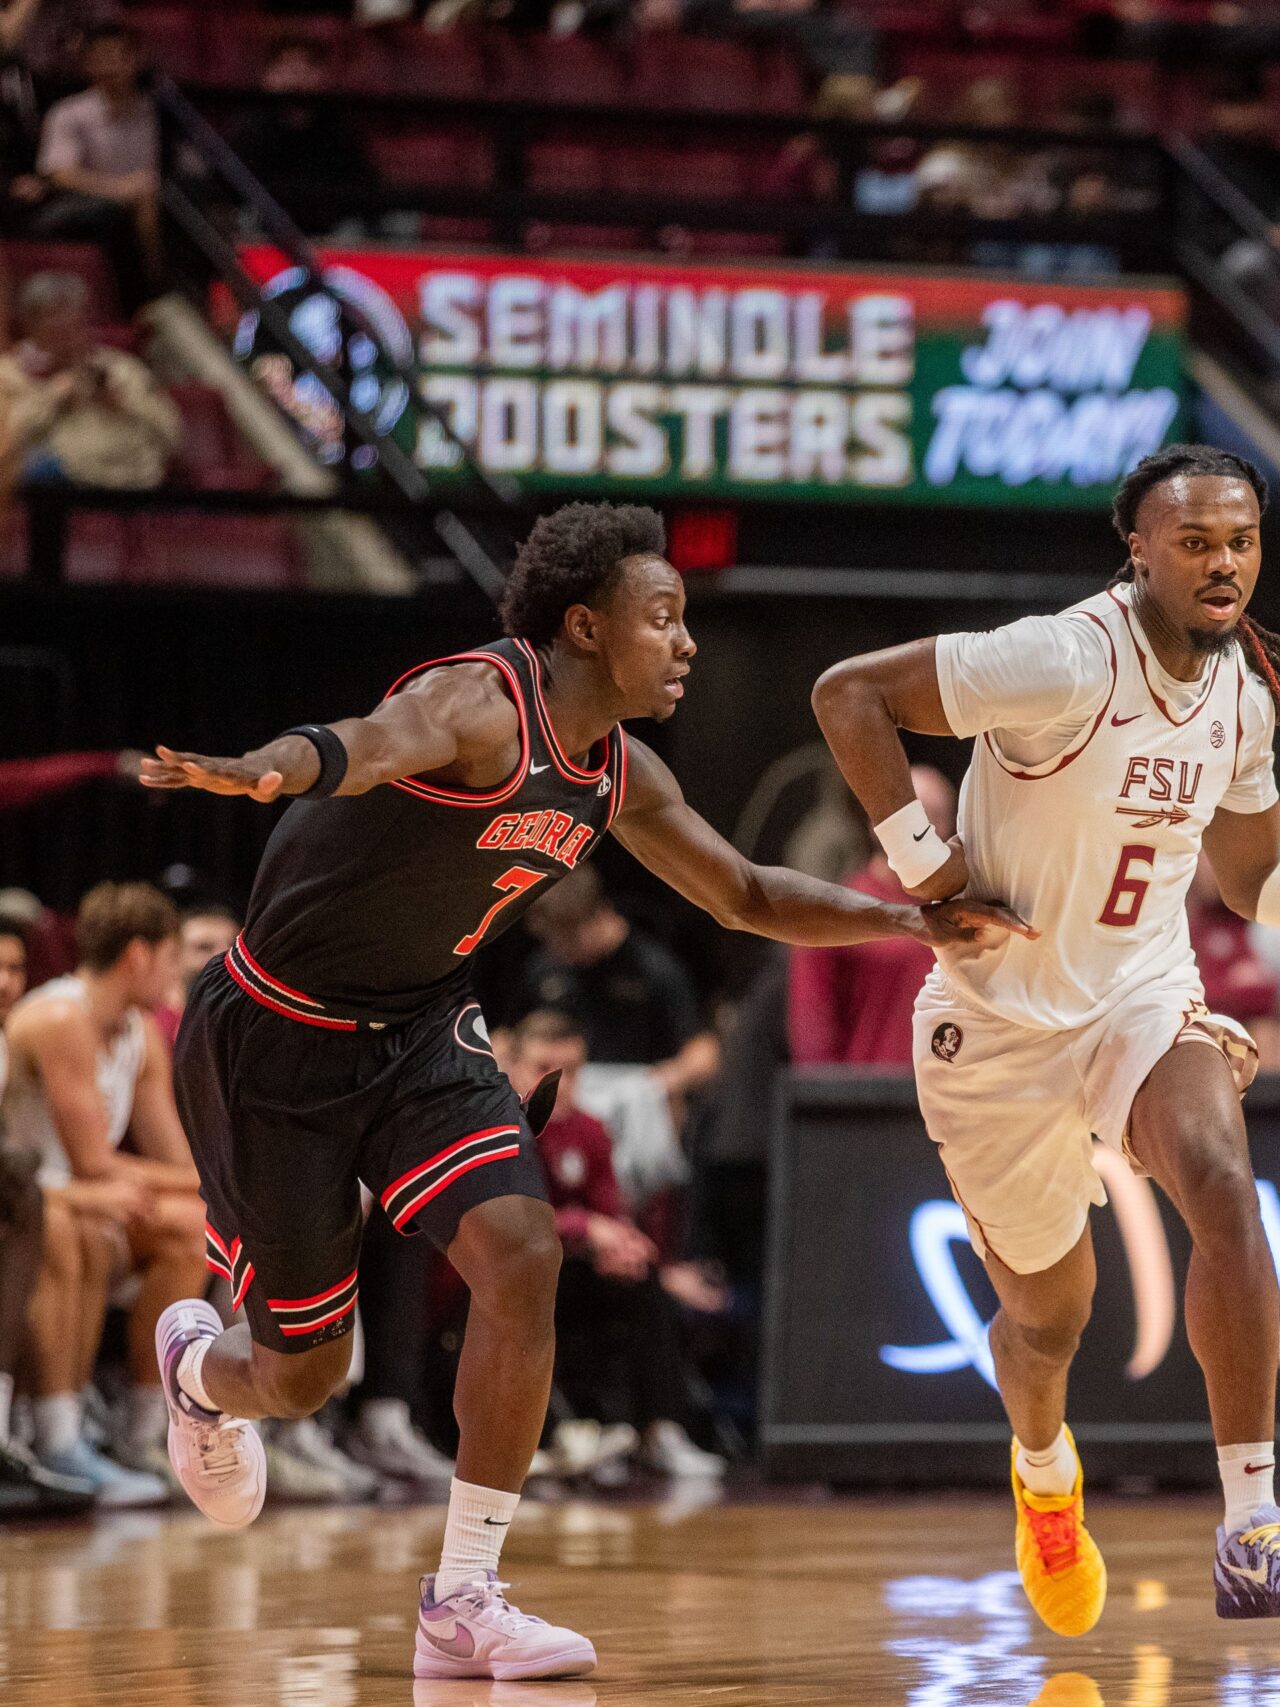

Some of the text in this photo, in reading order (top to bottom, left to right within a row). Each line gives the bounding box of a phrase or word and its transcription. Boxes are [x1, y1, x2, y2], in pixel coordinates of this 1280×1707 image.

[417, 270, 914, 384] SEMINOLE
[1118, 756, 1203, 804] FSU
[453, 866, 549, 955] 7
[1096, 842, 1156, 929] 6
